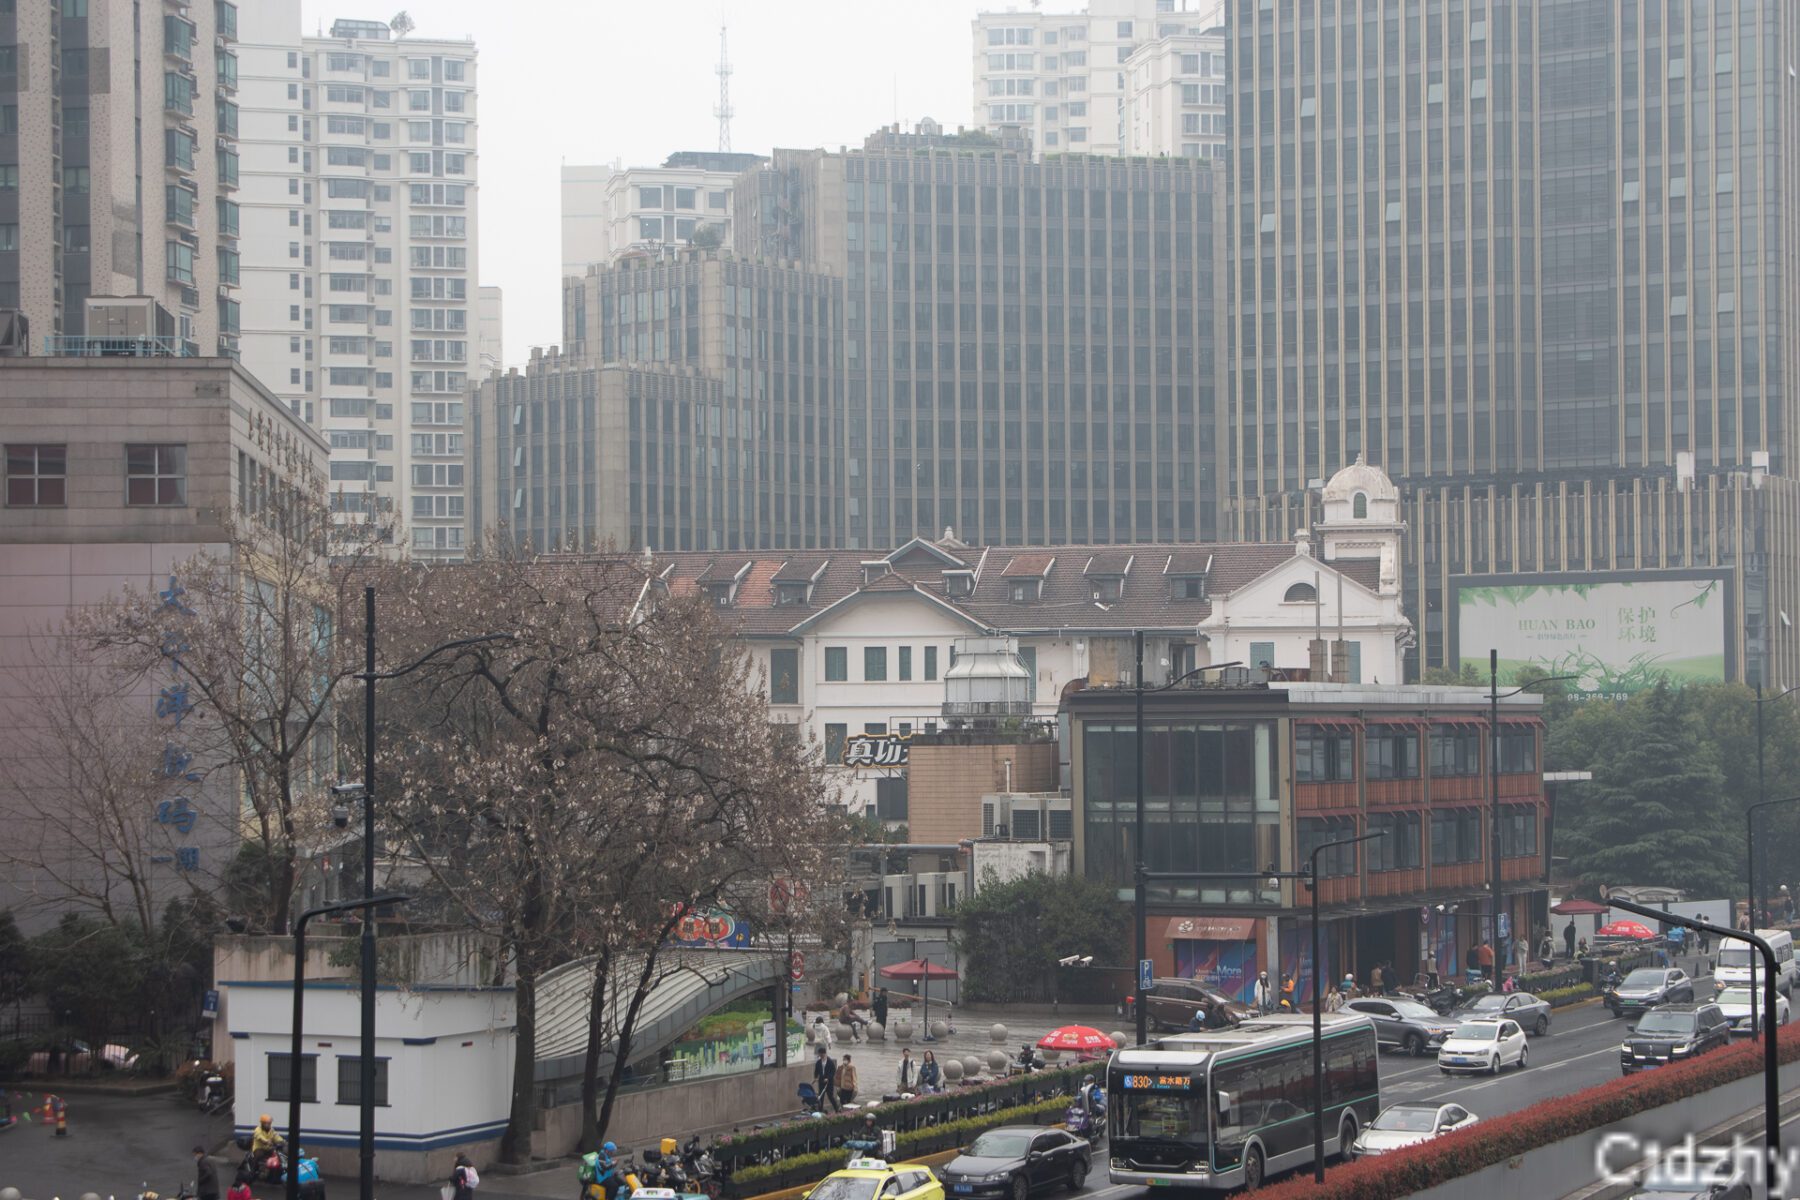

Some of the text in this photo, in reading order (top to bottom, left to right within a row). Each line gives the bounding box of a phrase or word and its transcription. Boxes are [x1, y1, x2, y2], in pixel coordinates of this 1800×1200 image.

[1618, 606, 1656, 624] 保护
[1518, 618, 1596, 631] HUAN BAO
[1618, 626, 1657, 643] 环境
[845, 737, 909, 764] 真功
[1144, 961, 1150, 976] P
[1216, 965, 1242, 976] More
[1132, 1075, 1149, 1088] 830
